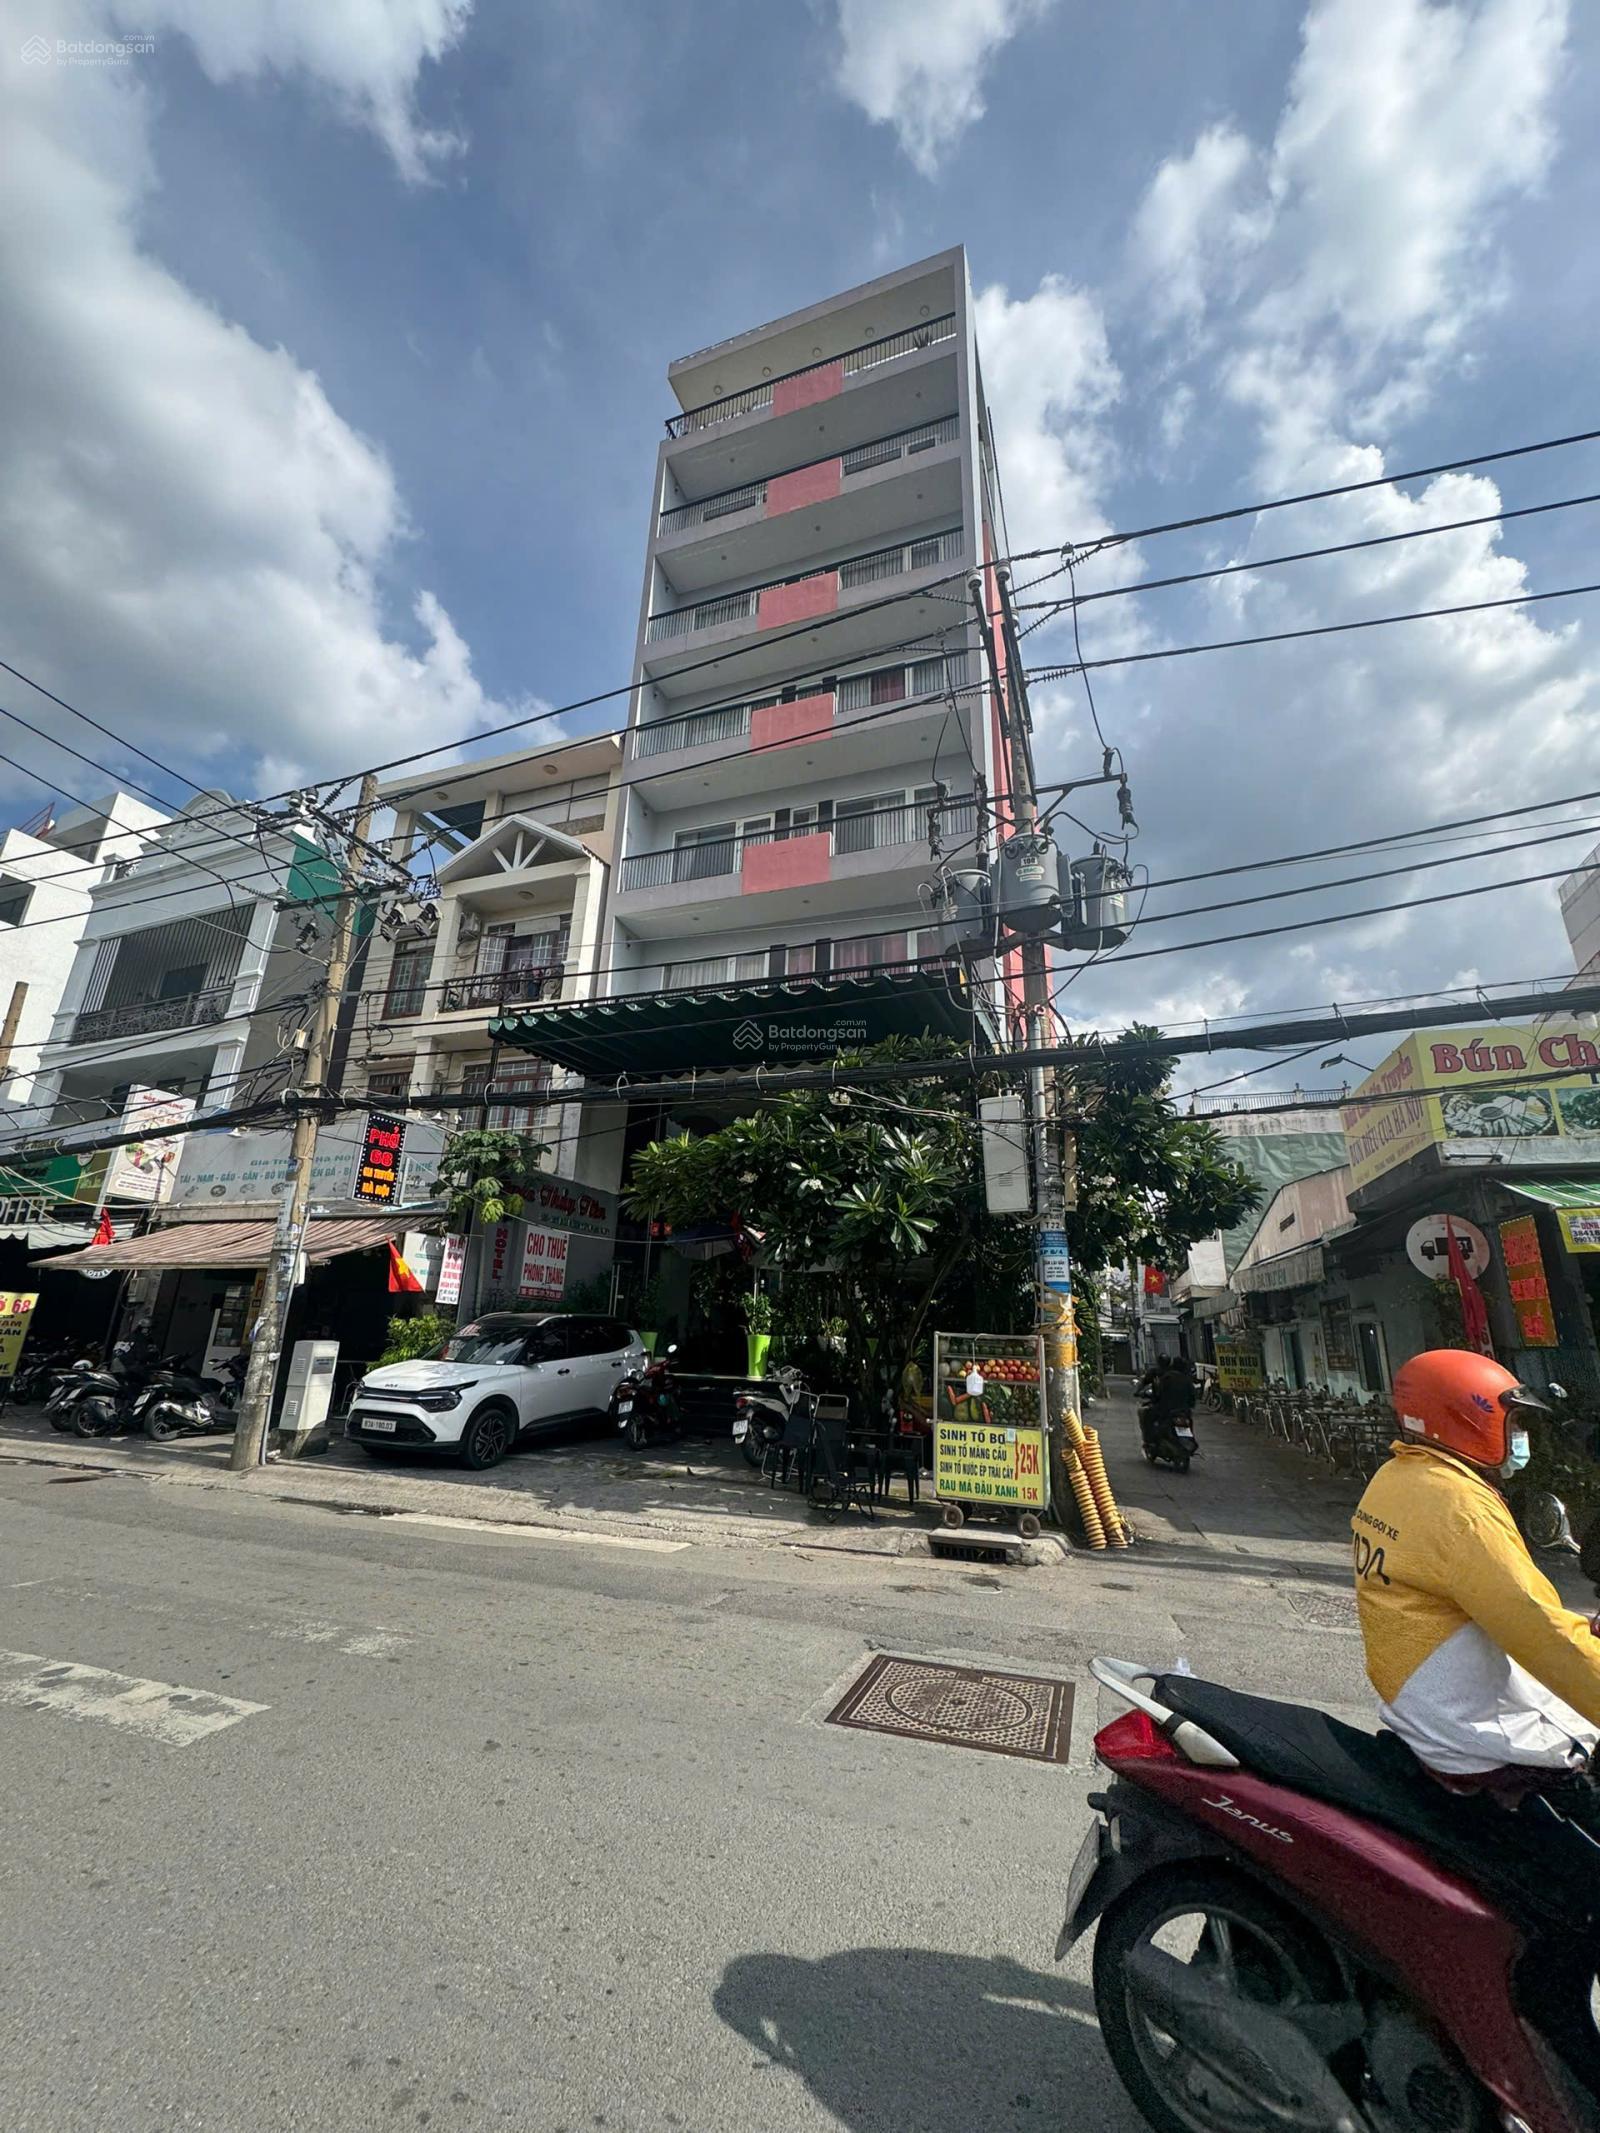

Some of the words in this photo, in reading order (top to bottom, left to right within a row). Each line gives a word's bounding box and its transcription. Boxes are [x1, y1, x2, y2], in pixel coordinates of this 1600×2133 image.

[1430, 1038, 1527, 1073] Bún
[1538, 1033, 1600, 1068] Ch
[369, 1126, 400, 1149] PHỞ
[370, 1149, 393, 1167] 68
[492, 1228, 509, 1280] HOTEL
[527, 1233, 545, 1256] CHO
[11, 1298, 32, 1314] 68
[940, 1429, 967, 1441] SINH
[970, 1428, 986, 1443] TỐ
[989, 1432, 1006, 1445] BƠ
[940, 1444, 957, 1457] SINH
[958, 1443, 968, 1458] TỐ
[1020, 1443, 1040, 1475] 25K
[940, 1461, 953, 1473] SINH
[954, 1459, 961, 1475] TỐ
[940, 1479, 956, 1492] RAU
[959, 1479, 972, 1494] MÁ
[975, 1480, 992, 1497] ĐẬU
[994, 1484, 1018, 1498] XANH
[1022, 1487, 1038, 1500] 15K
[1387, 1525, 1400, 1541] XE
[1201, 1794, 1295, 1844] Janus
